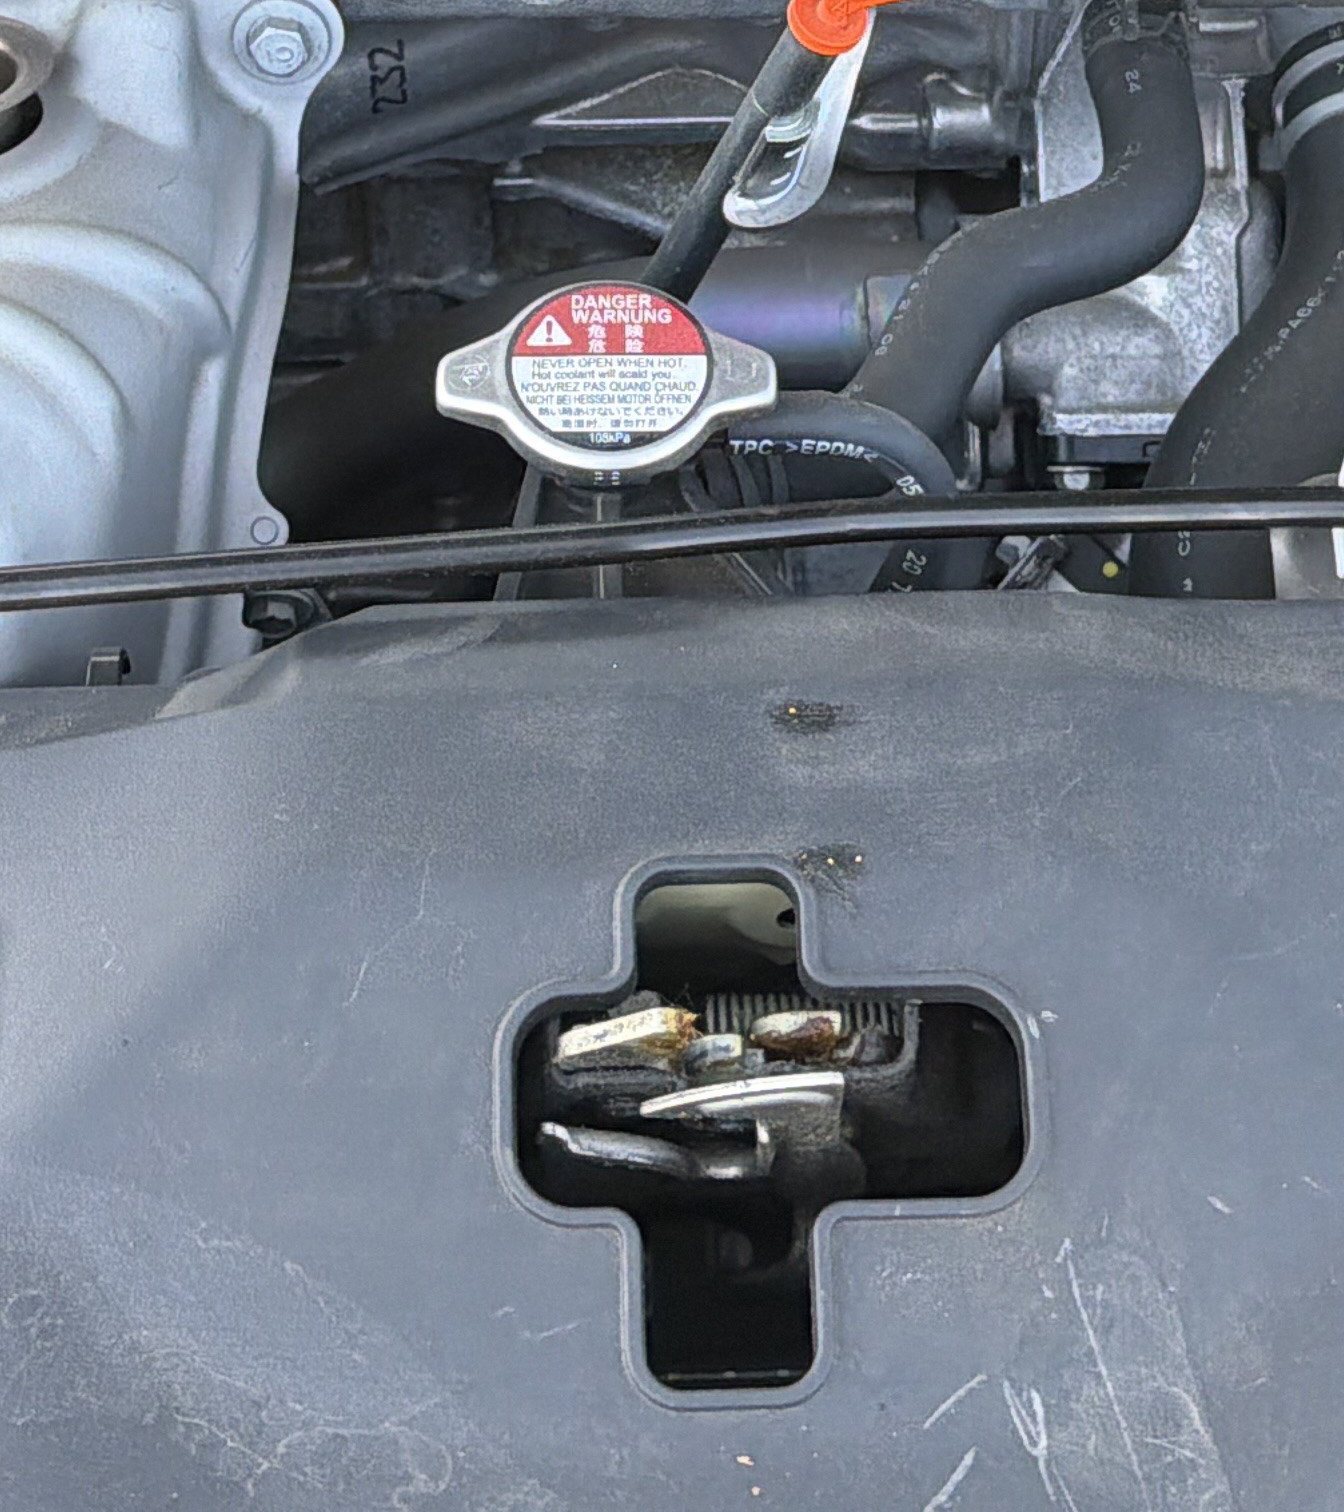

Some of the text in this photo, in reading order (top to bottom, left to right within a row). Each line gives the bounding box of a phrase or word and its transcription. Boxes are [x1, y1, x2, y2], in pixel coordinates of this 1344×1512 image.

[571, 294, 653, 310] DANGER
[571, 308, 673, 324] WARNUNG
[532, 358, 575, 369] NEVER
[578, 357, 613, 368] OPEN
[617, 357, 654, 368] WHEN
[555, 369, 596, 380] coolant
[583, 381, 607, 392] PAS
[608, 381, 652, 393] QUAND
[729, 439, 775, 456] TPC
